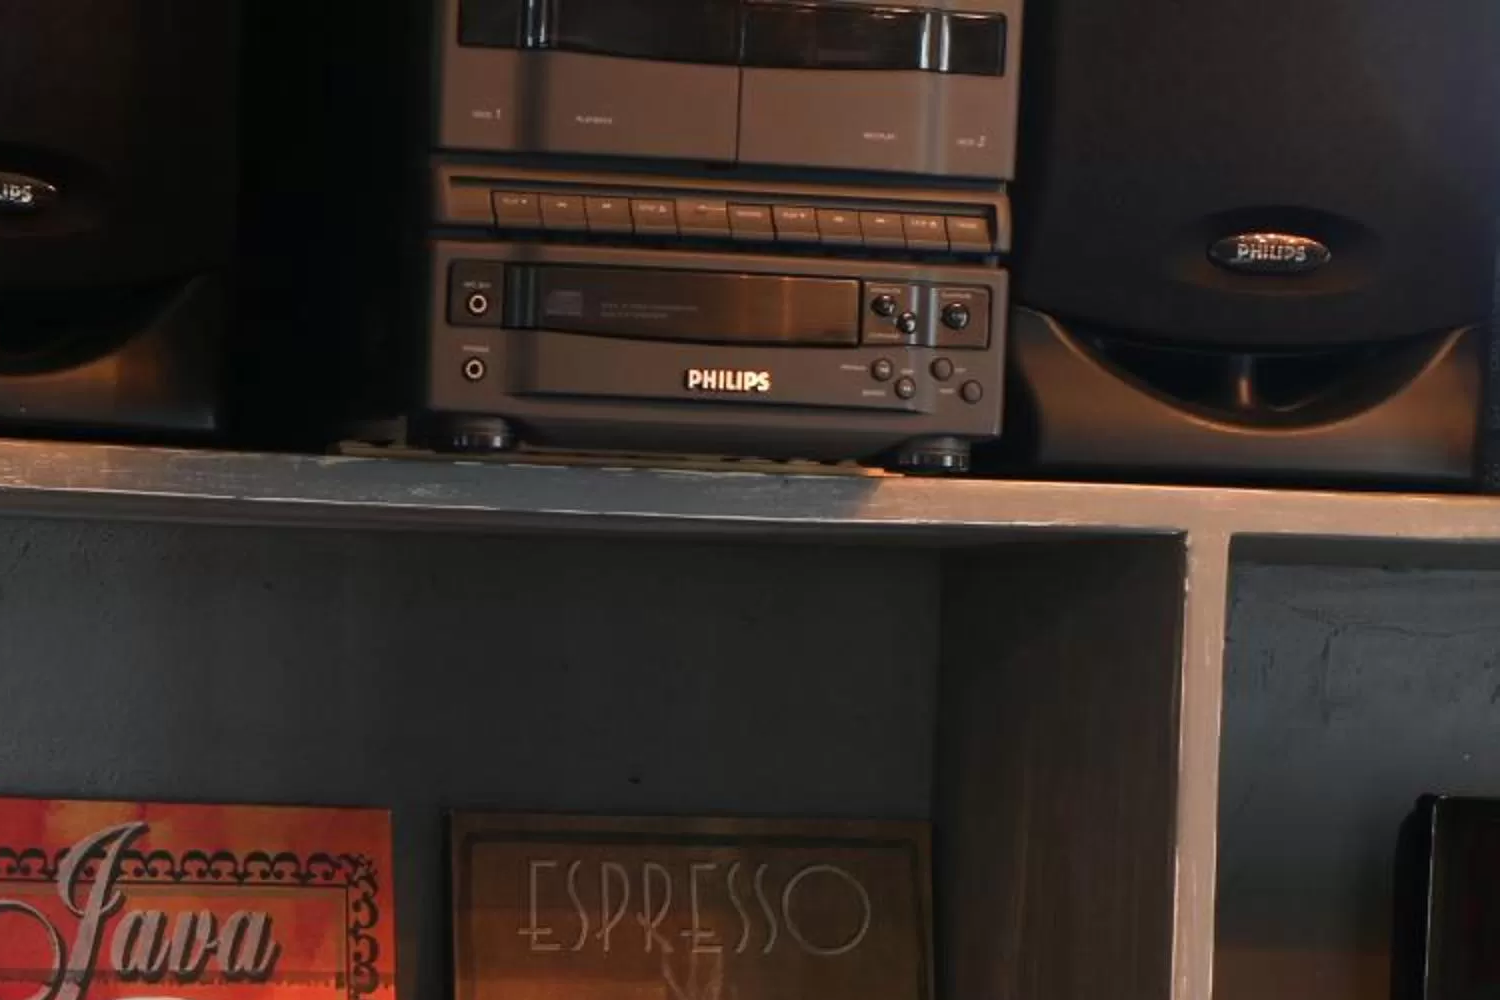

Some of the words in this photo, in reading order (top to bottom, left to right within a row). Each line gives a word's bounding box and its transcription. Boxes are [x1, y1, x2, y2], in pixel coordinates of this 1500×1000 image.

[1237, 243, 1307, 262] PHILIPS
[687, 369, 771, 392] PHILIPS
[517, 858, 872, 956] ESPRESSO
